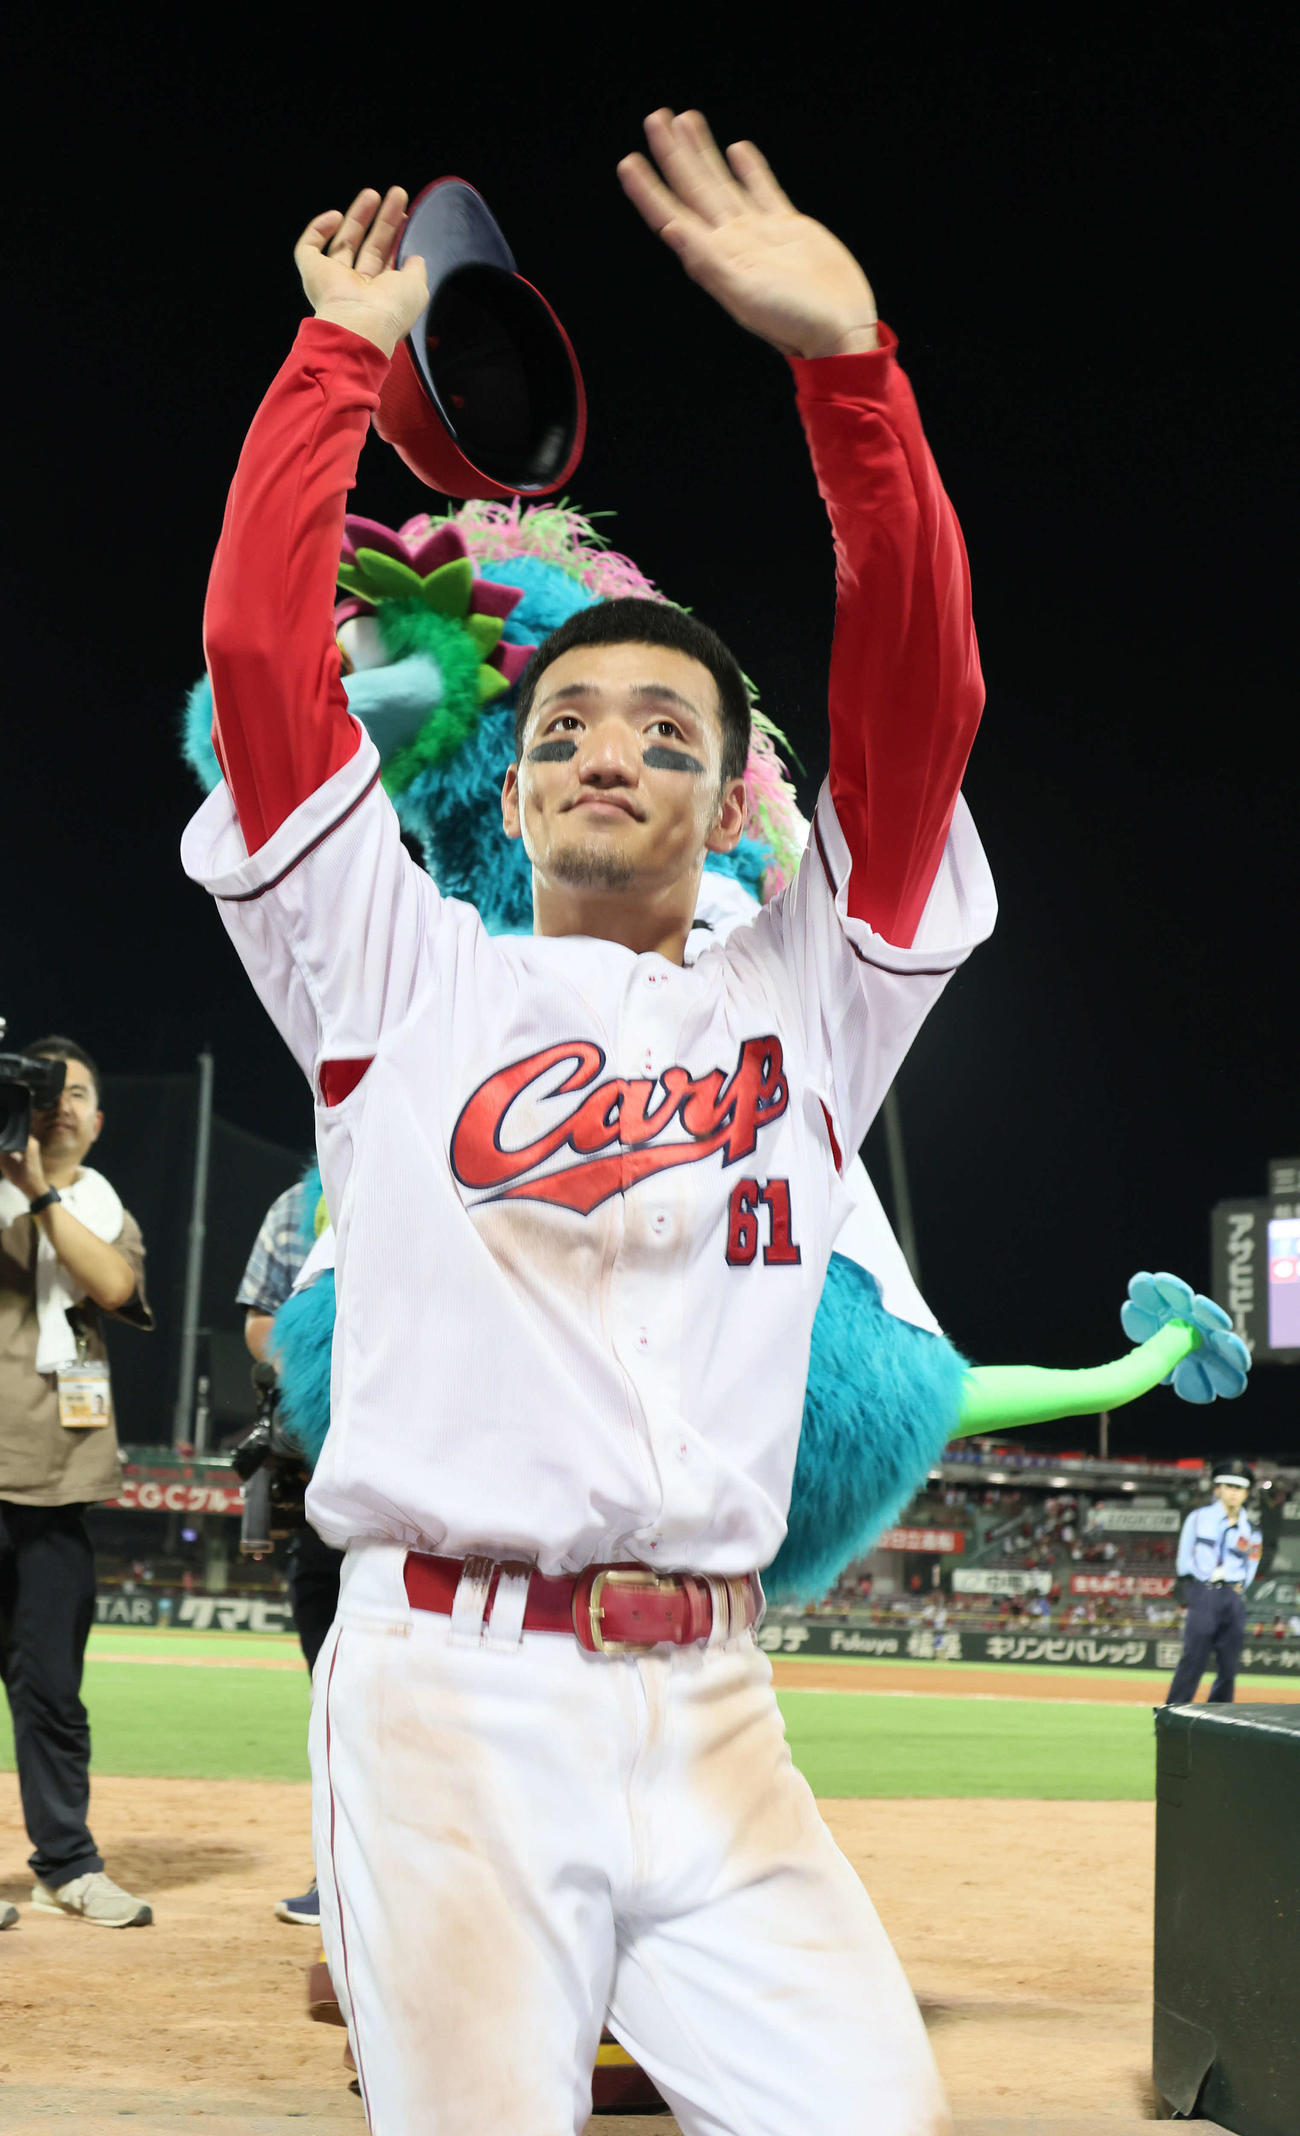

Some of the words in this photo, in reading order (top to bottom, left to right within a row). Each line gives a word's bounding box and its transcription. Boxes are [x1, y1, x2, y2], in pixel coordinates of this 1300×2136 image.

[450, 1034, 790, 1216] Carp
[725, 1178, 802, 1266] 61
[830, 1630, 899, 1655] Fukuya
